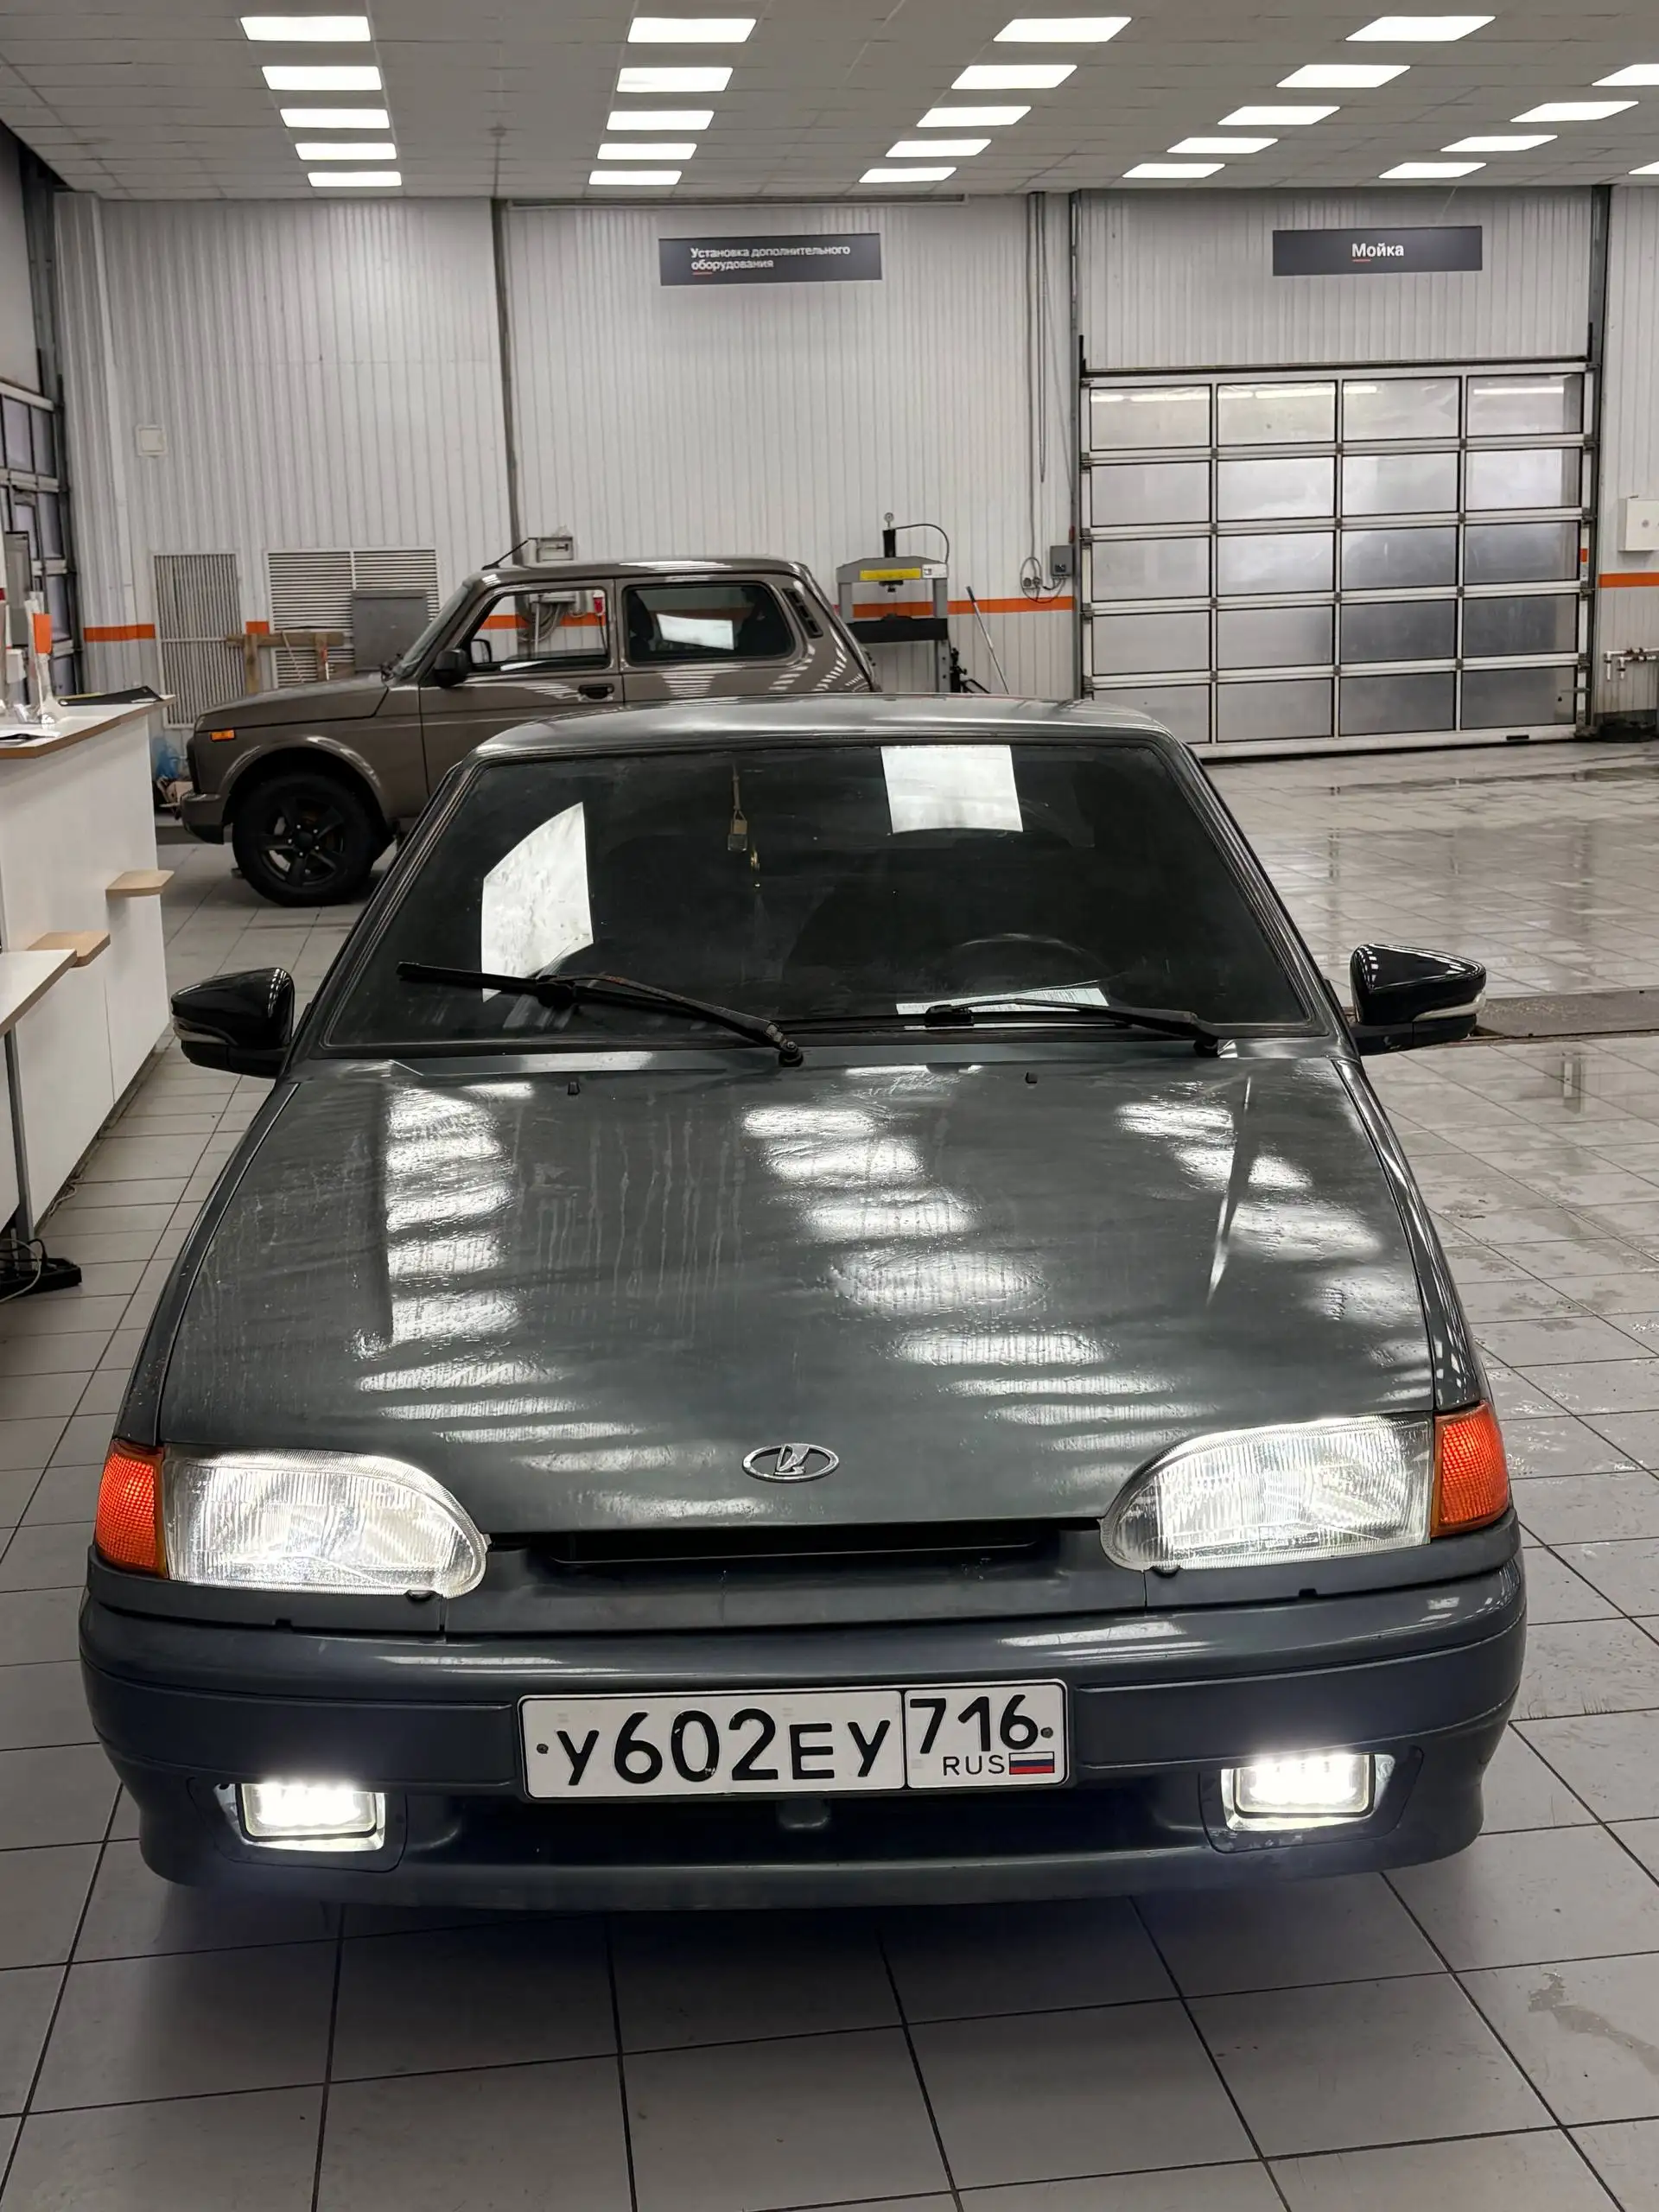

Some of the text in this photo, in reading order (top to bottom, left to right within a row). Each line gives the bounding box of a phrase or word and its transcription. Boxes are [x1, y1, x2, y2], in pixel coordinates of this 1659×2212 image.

[690, 245, 851, 259] Установка дополнительного
[1351, 243, 1405, 257] Мойка
[690, 259, 774, 272] оборудования
[909, 1694, 1039, 1755] 716
[942, 1753, 1007, 1777] RUS
